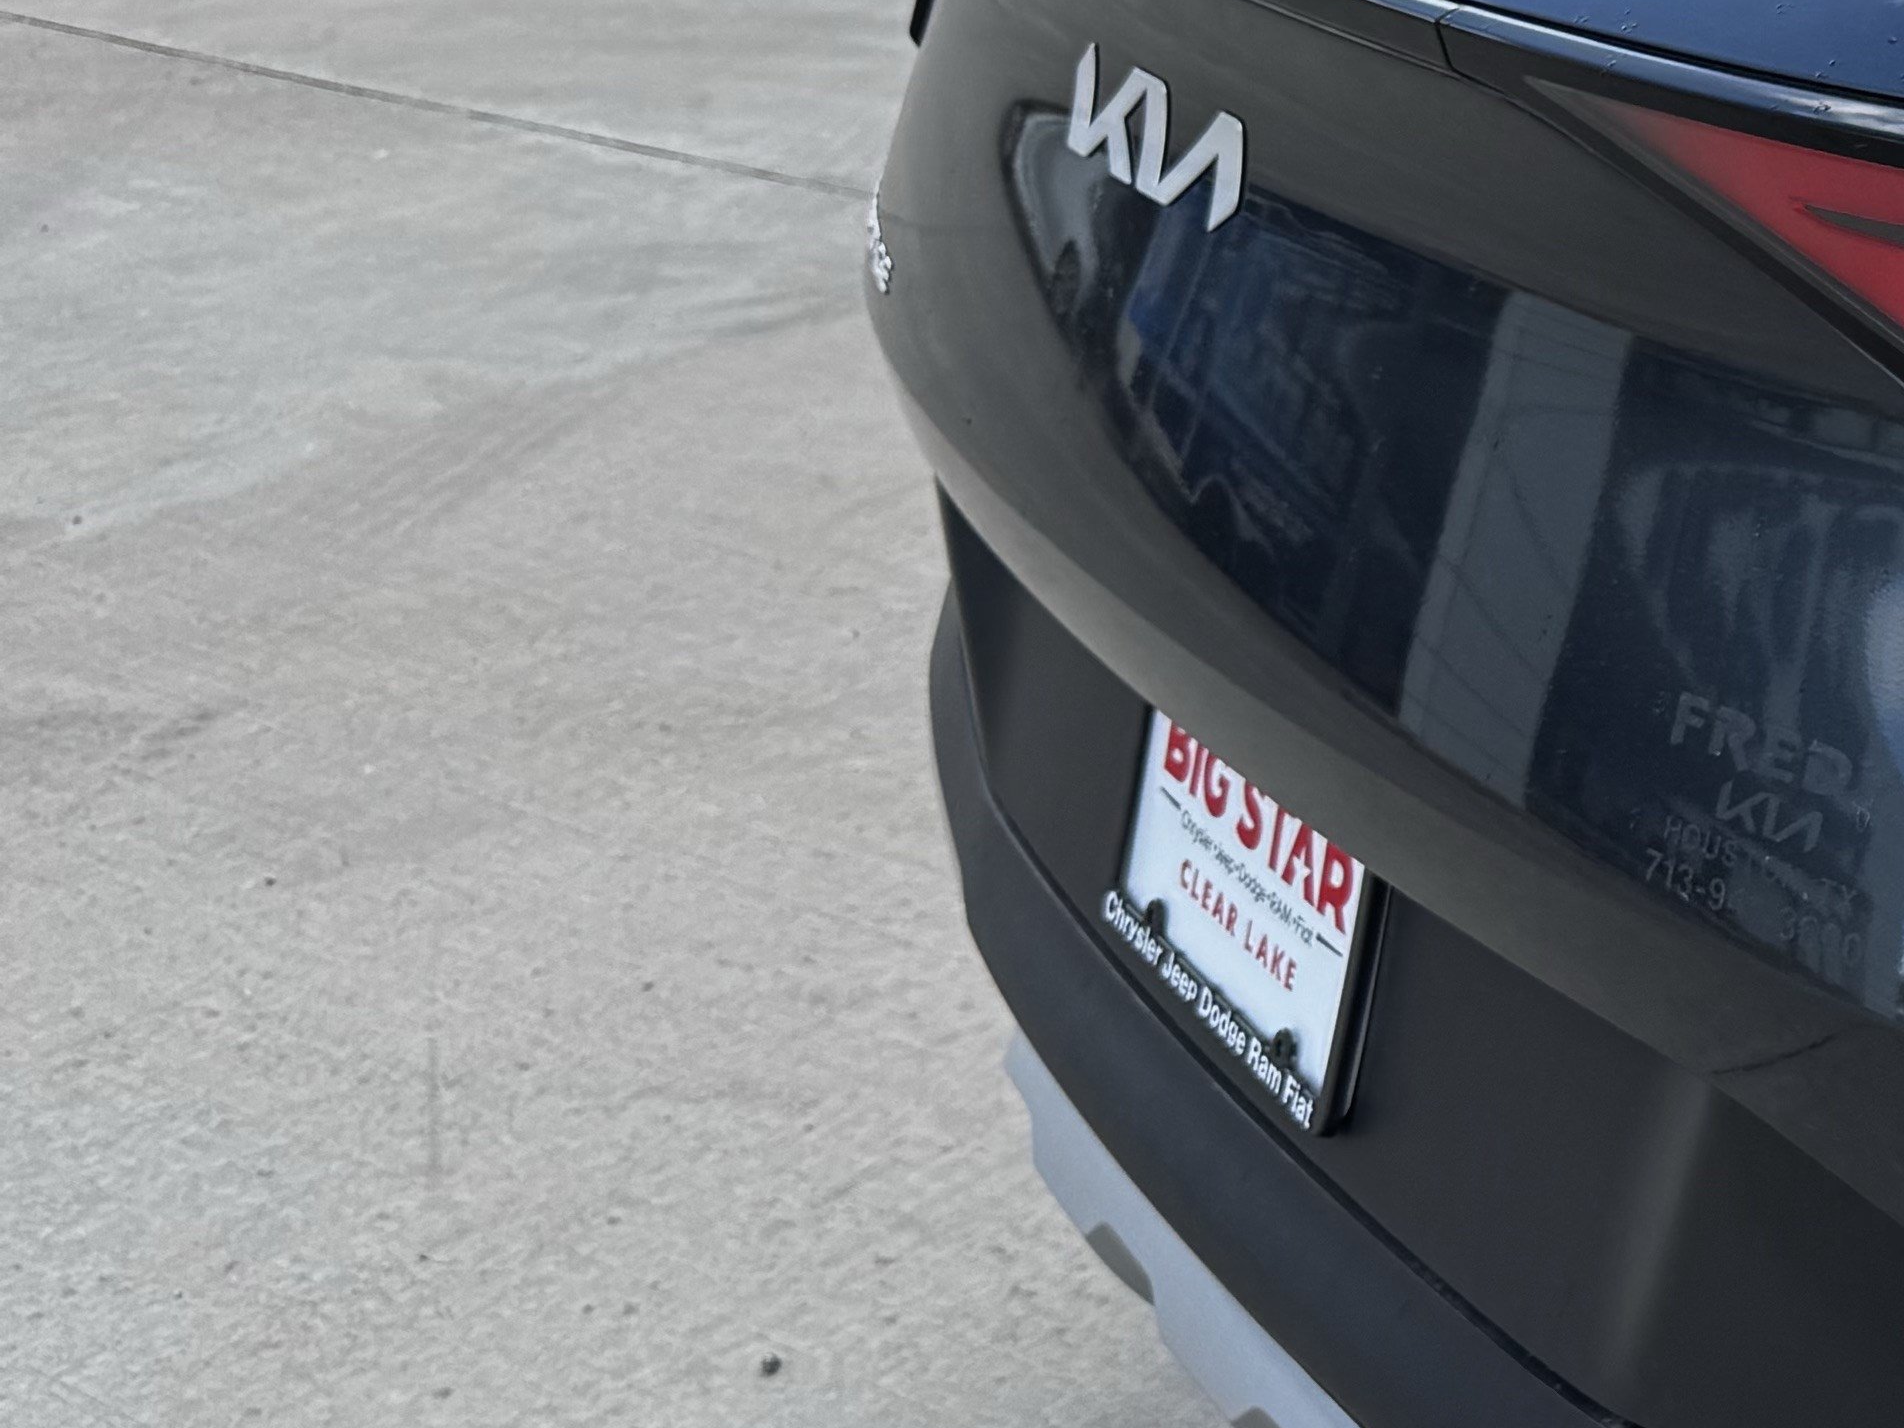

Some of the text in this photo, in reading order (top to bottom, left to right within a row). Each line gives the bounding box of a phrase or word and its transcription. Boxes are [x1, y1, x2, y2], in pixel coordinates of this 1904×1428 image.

[1068, 42, 1243, 233] KIA
[1163, 721, 1354, 934] BIG STAR
[1715, 779, 1824, 854] KIA
[1105, 890, 1314, 1130] Chrysler Jeep Dodge Ram Fiat
[1180, 858, 1298, 992] CLEAR LAKE
